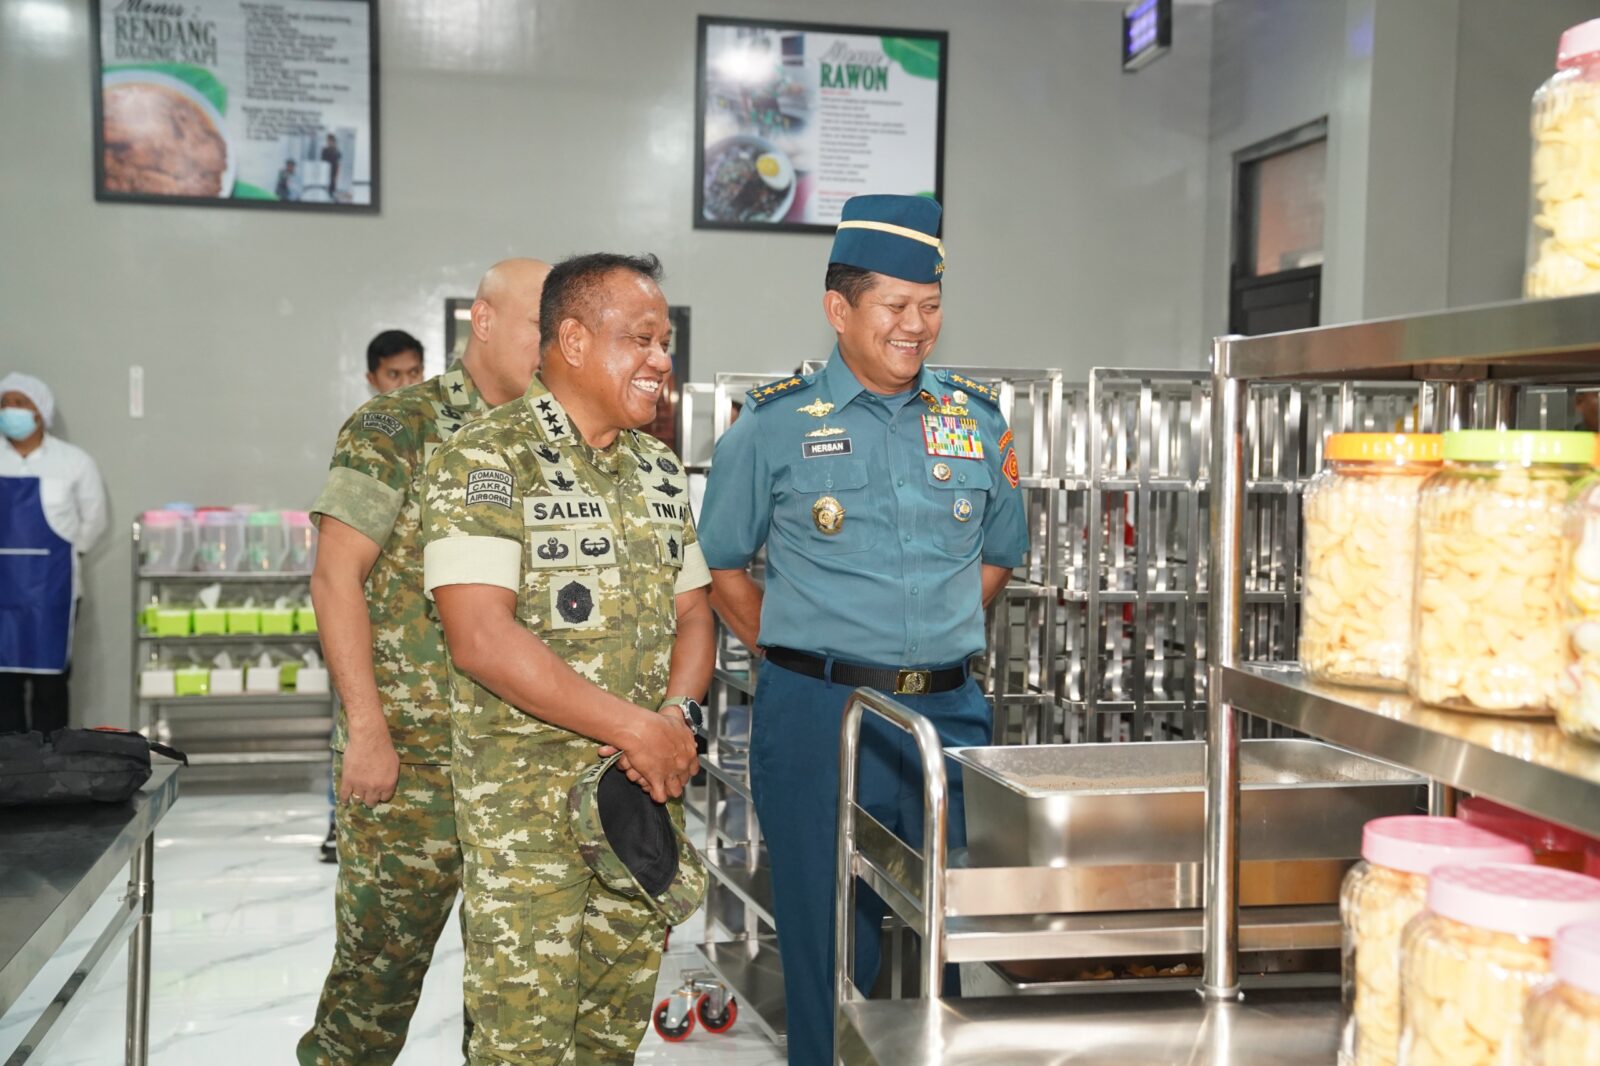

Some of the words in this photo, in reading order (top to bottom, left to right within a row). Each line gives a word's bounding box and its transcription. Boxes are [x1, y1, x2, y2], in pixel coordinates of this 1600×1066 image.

[115, 16, 217, 48] RENDANG
[820, 62, 889, 92] RAWON
[471, 471, 510, 484] KOMANDO
[472, 482, 508, 495] CAKRA
[470, 493, 510, 505] AIRBORNE
[533, 502, 603, 520] SALEH
[652, 502, 677, 519] TNI
